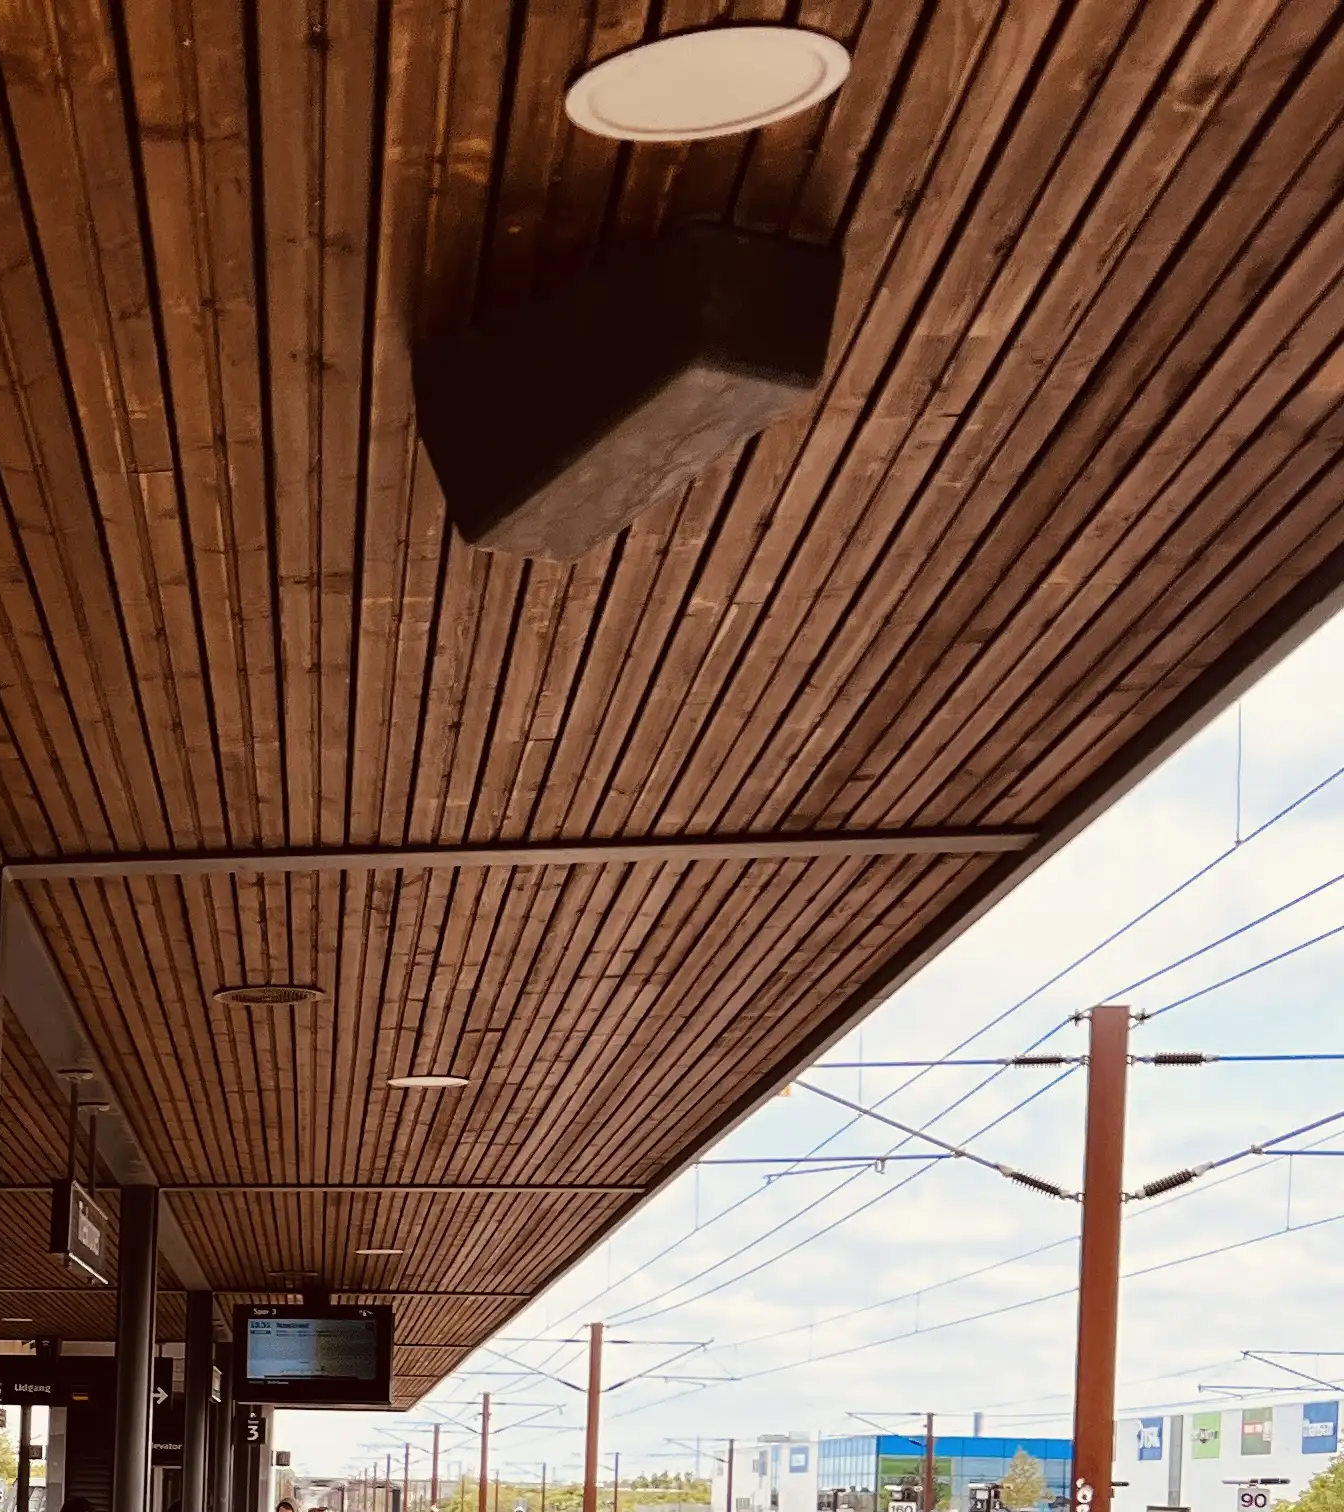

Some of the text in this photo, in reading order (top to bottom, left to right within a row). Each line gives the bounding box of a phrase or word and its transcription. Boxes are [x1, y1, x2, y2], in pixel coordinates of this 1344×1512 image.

[14, 1383, 52, 1393] Udgang
[247, 1425, 260, 1441] 3
[1240, 1492, 1268, 1508] 90
